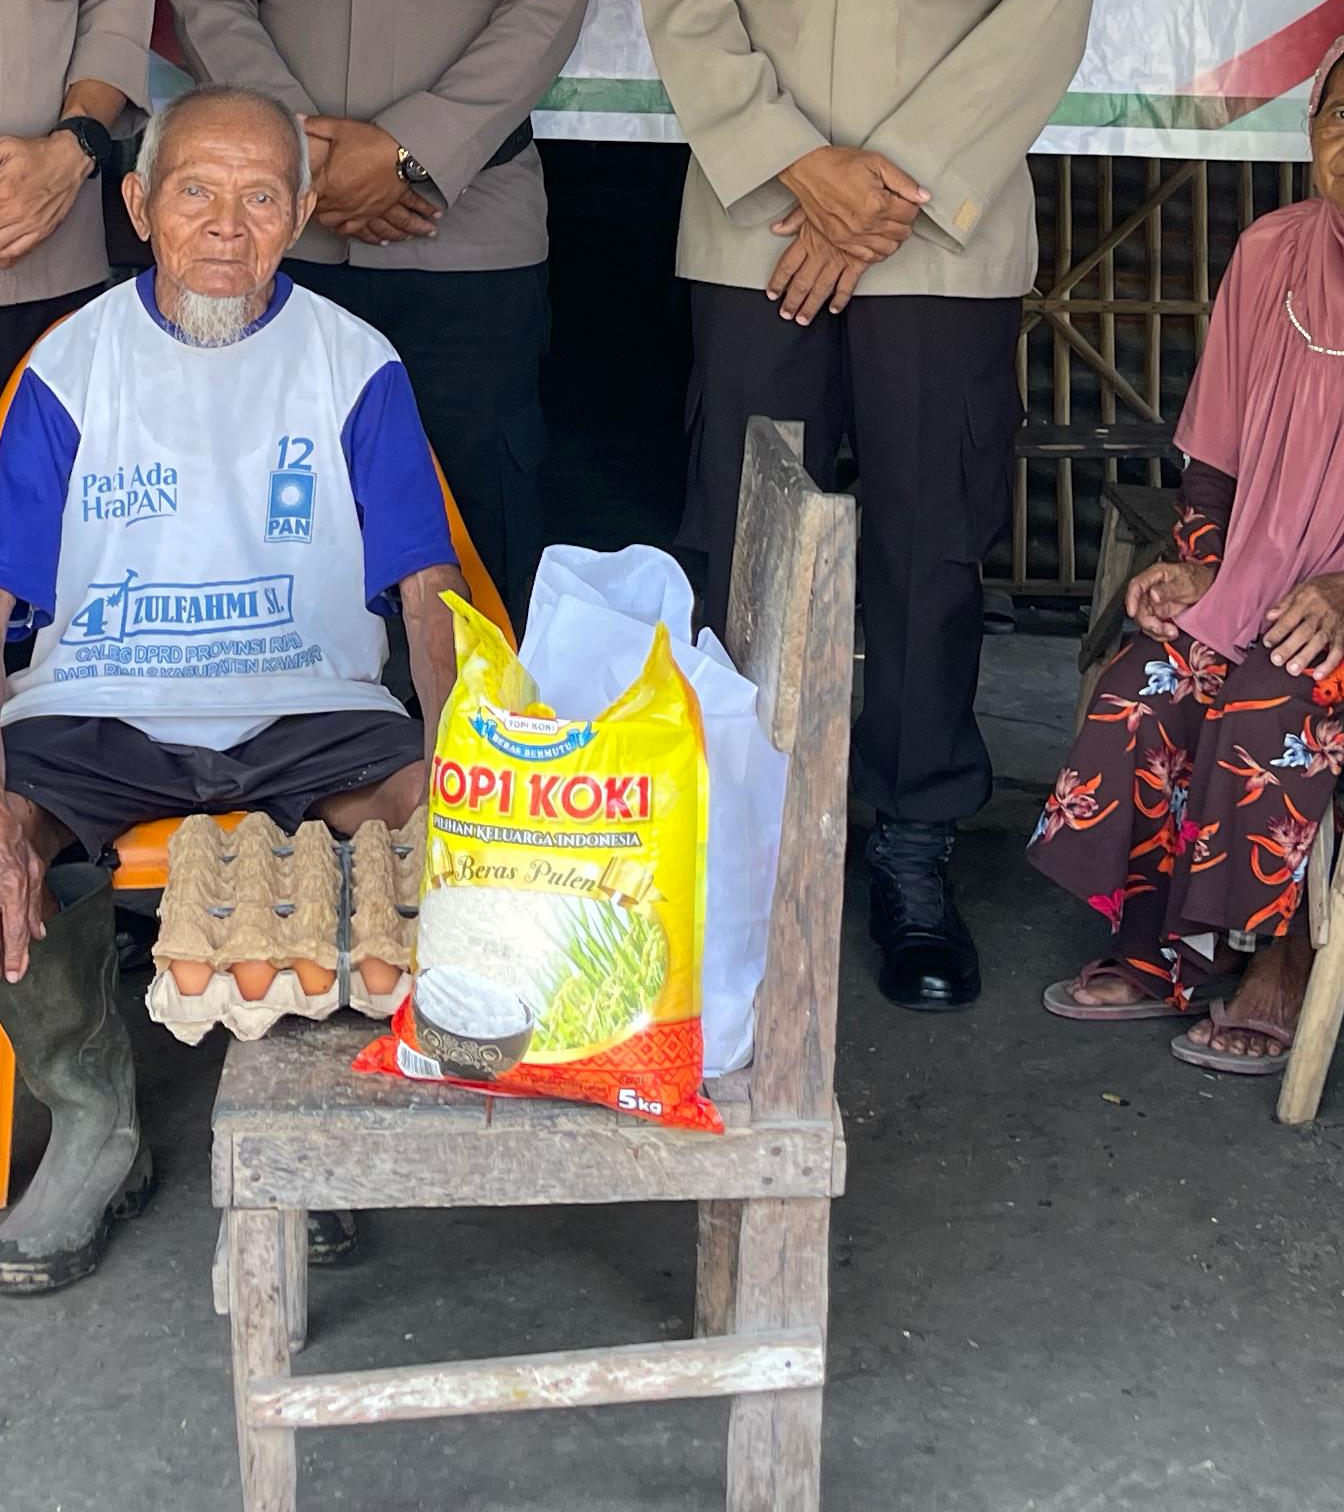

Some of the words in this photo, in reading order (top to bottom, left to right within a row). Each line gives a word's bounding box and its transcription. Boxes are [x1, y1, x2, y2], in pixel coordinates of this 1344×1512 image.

[277, 435, 314, 471] 12
[130, 462, 177, 487] Ada
[268, 518, 310, 536] PAN
[132, 590, 259, 626] ZULFAHMI
[75, 643, 133, 665] CALEG
[134, 644, 183, 664] DPRD
[185, 637, 267, 664] PROVINSI
[509, 719, 530, 729] TOPI
[531, 722, 555, 732] KOKI
[432, 755, 513, 815] TOPI
[528, 773, 650, 820] KOKI
[476, 824, 553, 844] KELUARGA
[555, 832, 642, 848] INDONESIA
[456, 854, 518, 882] Beras
[523, 858, 598, 892] Pulen
